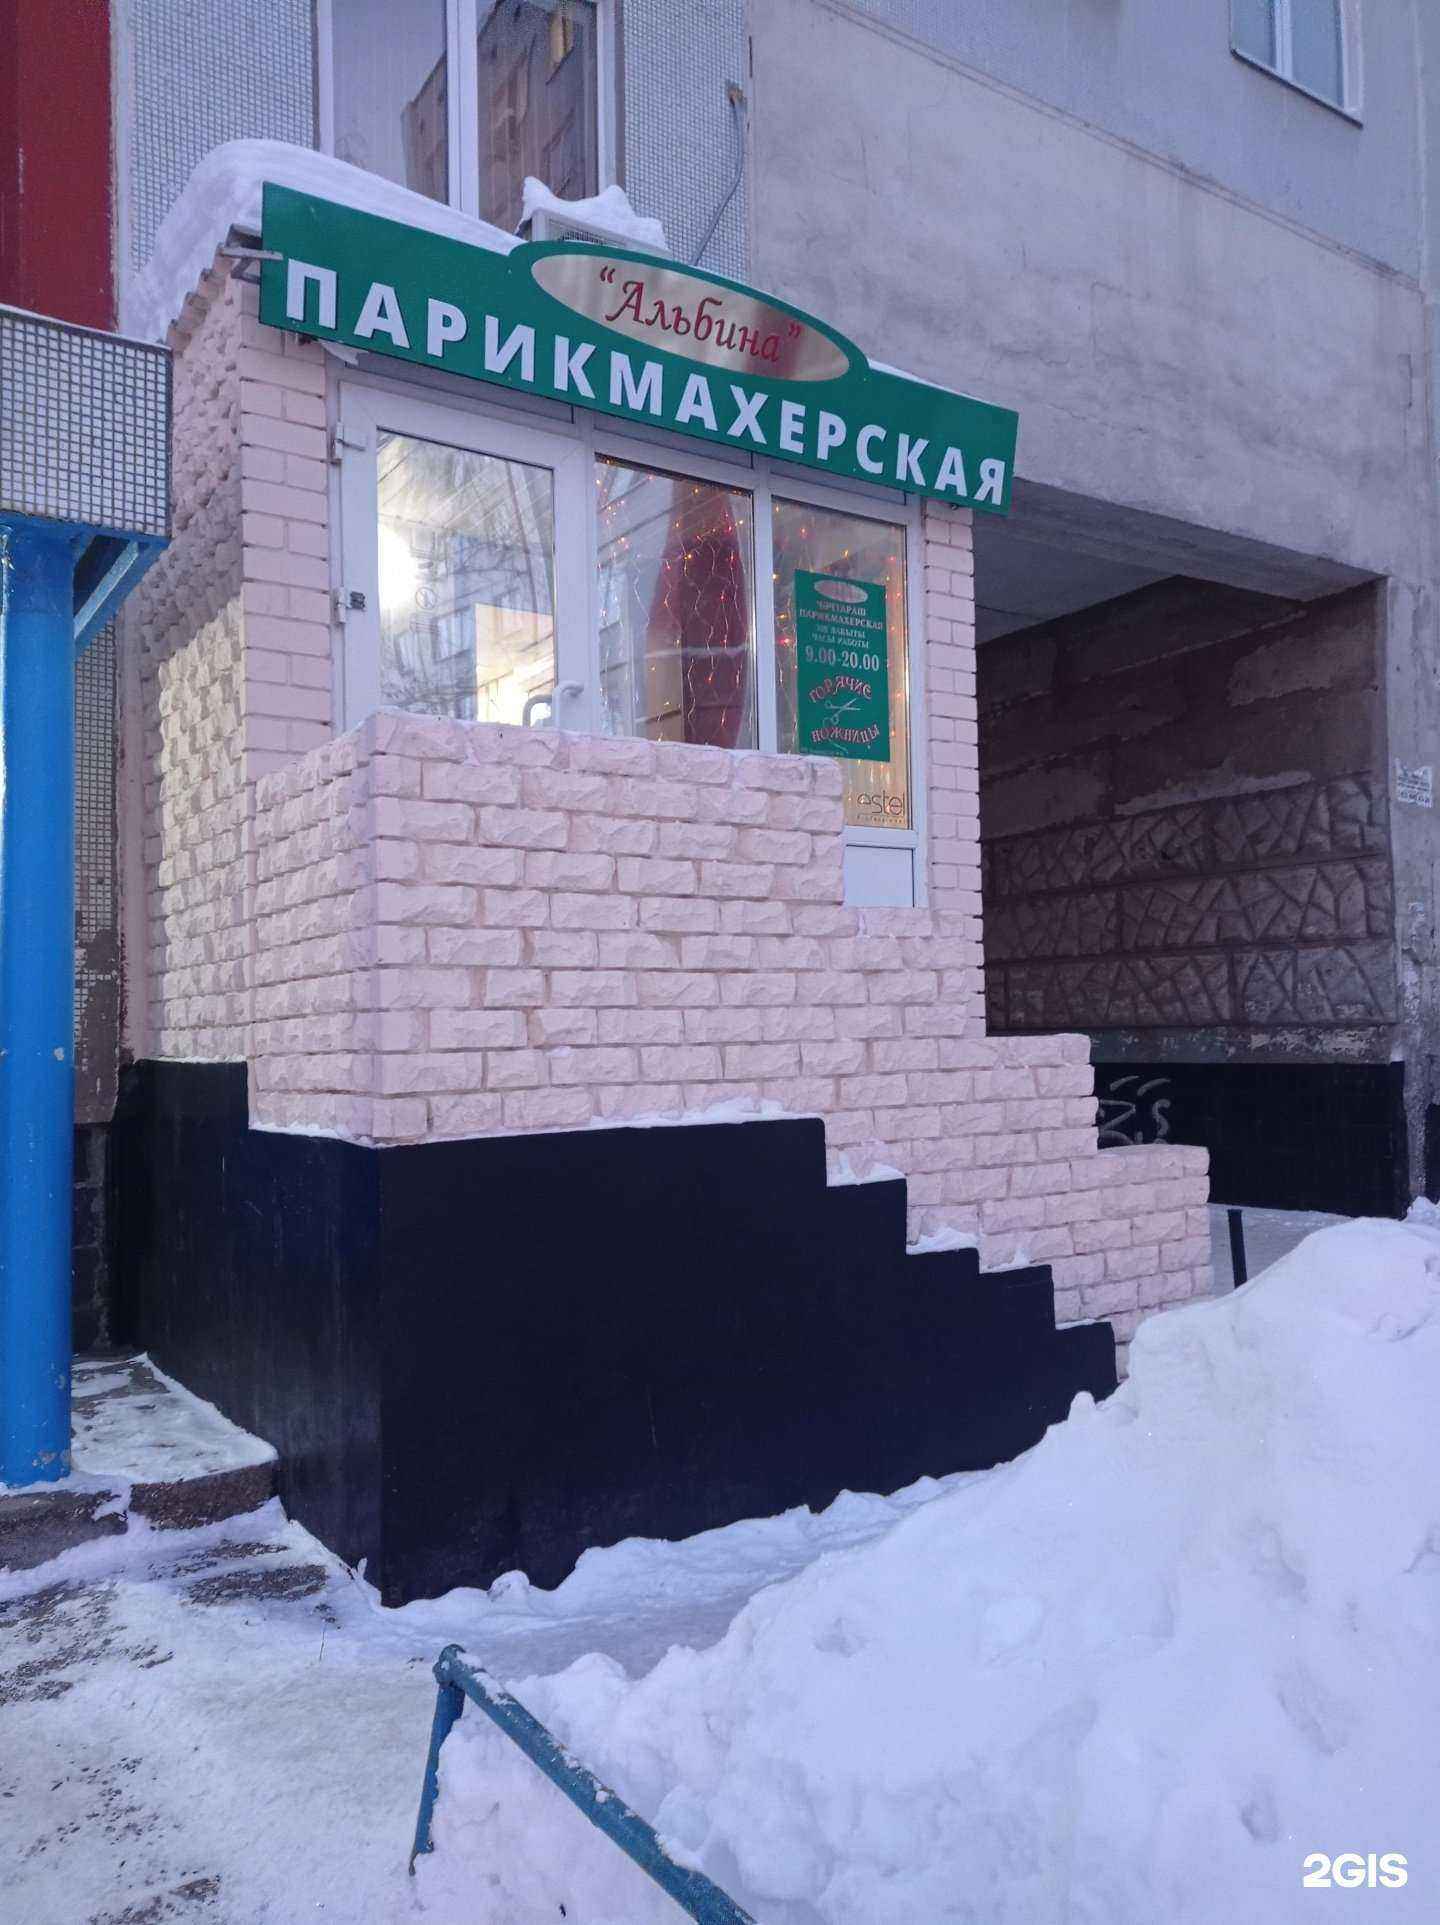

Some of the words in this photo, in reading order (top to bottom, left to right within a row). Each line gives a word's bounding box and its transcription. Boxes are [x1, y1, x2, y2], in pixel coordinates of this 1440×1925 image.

[285, 258, 1007, 506] ПАРИКМАХЕРСКАЯ
[805, 645, 880, 672] 9.00-20.00
[809, 675, 872, 704] ГОРЯЧИЕ
[811, 722, 880, 743] НОЖНИЦЫ
[857, 790, 905, 816] estel
